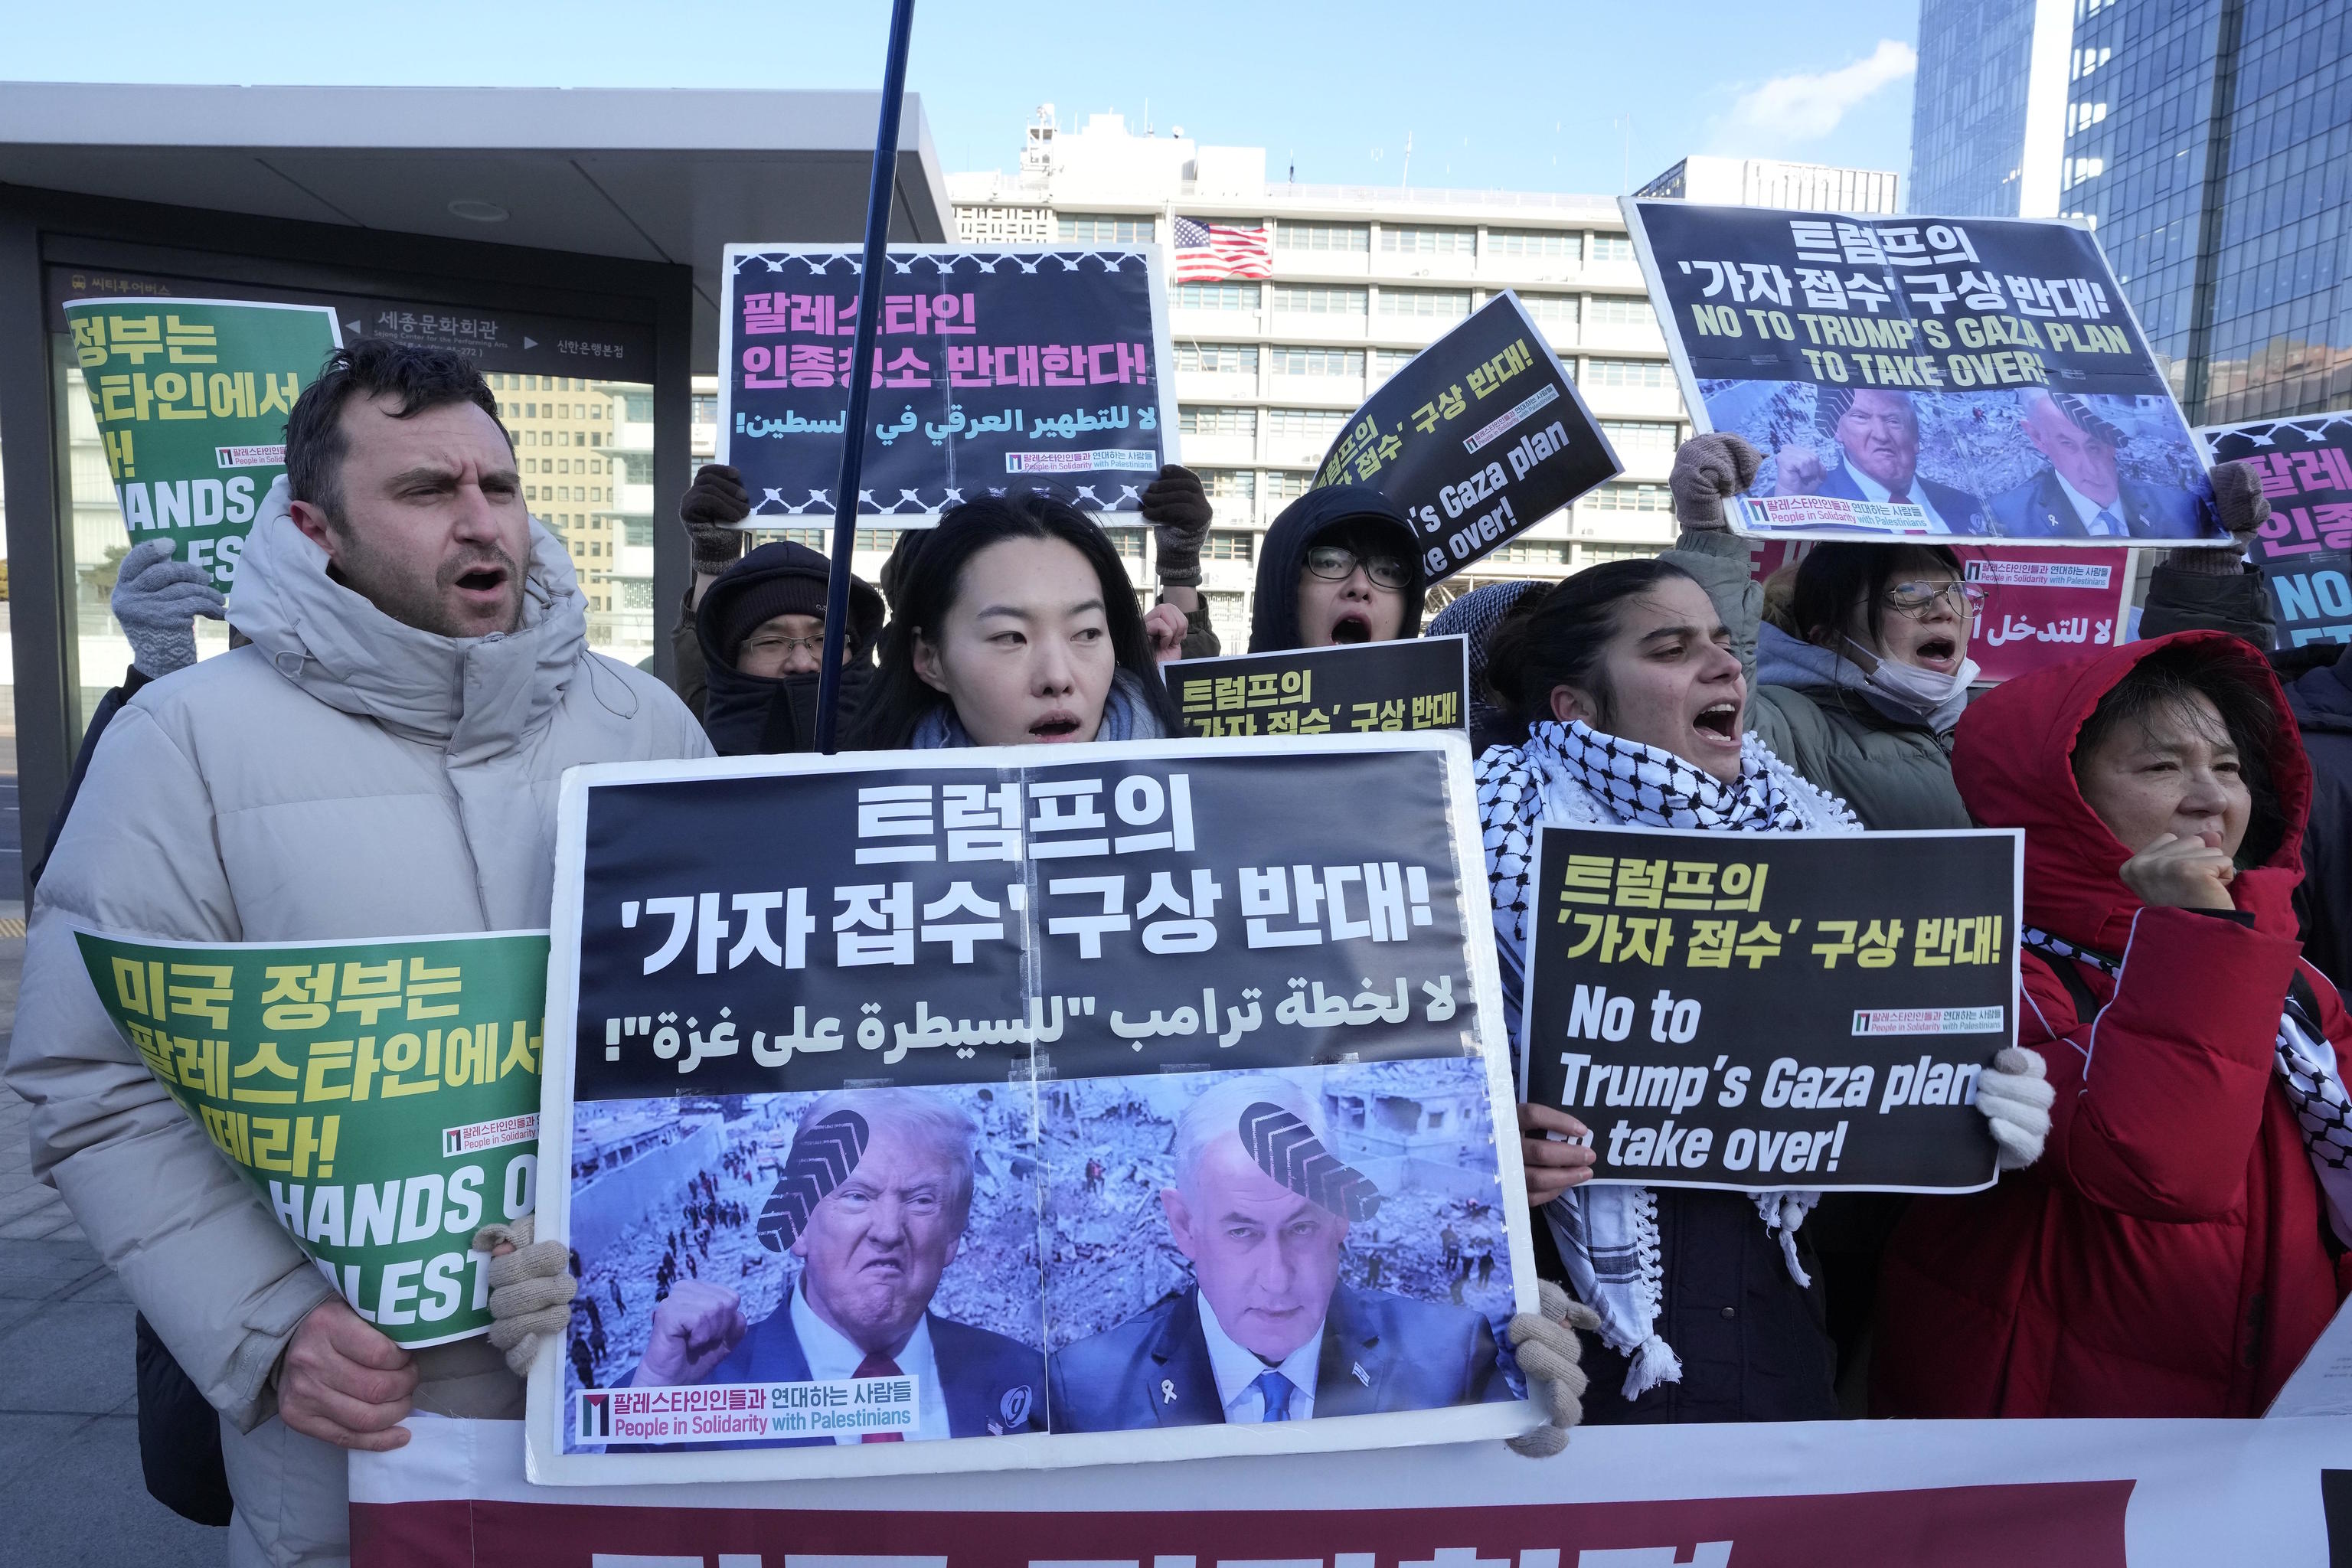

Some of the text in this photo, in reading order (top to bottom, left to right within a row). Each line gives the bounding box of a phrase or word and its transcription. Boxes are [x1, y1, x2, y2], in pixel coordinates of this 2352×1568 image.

[1789, 220, 1980, 266] 트럼프의
[92, 278, 171, 296] 씨티투어버스
[1678, 261, 2110, 318] '가자 접수' 구상 반대!
[70, 315, 217, 368] 정부는
[378, 312, 498, 340] 세종문화회관
[454, 338, 492, 348] Performing
[1690, 304, 2132, 354] NO TO TRUMP'S GAZA PLAN
[557, 340, 623, 358] 신한은행본점
[947, 342, 1146, 387] 반대한다!
[1801, 348, 2050, 387] TO TAKE OVER!
[1411, 384, 1466, 434] 구상
[1466, 338, 1534, 400] 반대!
[1515, 397, 1537, 414] 연대하는
[1537, 386, 1553, 400] 사람들
[876, 404, 917, 446] في
[925, 404, 1023, 446] العرقي
[1029, 405, 1130, 439] للتطهير
[1137, 407, 1157, 430] لا
[1478, 433, 1494, 446] People
[1498, 417, 1520, 433] Solidarity
[1519, 410, 1529, 419] with
[1528, 393, 1557, 413] Palestinians
[1024, 453, 1090, 462] 팔레스타인인들과
[1128, 452, 1152, 460] 사람들
[1024, 463, 1048, 472] People
[1059, 462, 1092, 470] Solidarity
[1439, 421, 1570, 518] Gaza plan
[1449, 496, 1517, 559] over!
[1766, 498, 1922, 517] 팔레스타인인들과 연대하는 사람들
[1771, 511, 1927, 527] People in Solidarity with Palestinians
[1981, 563, 2108, 577] 팔레스타인인들과 연대하는 사람들
[1981, 573, 2004, 582] People
[2005, 573, 2011, 582] in
[2014, 574, 2047, 584] Solidarity
[2066, 577, 2106, 586] Palestinians
[1987, 615, 2089, 646] للتدخل
[2094, 619, 2112, 644] لا
[1182, 669, 1312, 713] 트럼프의
[1351, 698, 1405, 732] 구상
[1413, 691, 1457, 730] 반대!
[855, 773, 1195, 865] 트럼프의
[1560, 854, 1769, 912] 트럼프의
[621, 862, 1432, 975] '가자 접수' 구상 반대!
[1557, 909, 2002, 969] '가자 접수' 구상 반대!
[112, 956, 462, 1031] 미국 정부는
[1275, 976, 1410, 1027] لخطة
[1421, 975, 1457, 1022] لا
[1566, 984, 1702, 1044] No to
[1110, 988, 1262, 1052] ترامب
[1871, 1024, 1896, 1033] People
[1906, 1023, 1940, 1033] Solidarity
[1960, 1021, 2001, 1030] Palestinians
[1872, 1009, 2001, 1021] 팔레스타인인들과 연대하는 사람들
[751, 1006, 844, 1068] على
[1560, 1052, 1982, 1115] Trump's Gaza plan
[199, 1103, 340, 1178] 떼라!
[463, 1116, 534, 1138] 팔레스타인인들과
[464, 1129, 536, 1150] People in Solidarity
[1607, 1120, 1713, 1168] take
[1723, 1120, 1849, 1174] over!
[269, 1165, 484, 1247] HANDS
[614, 1381, 911, 1415] 팔레스타인인들과 연대하는 사람들
[615, 1409, 911, 1439] People in Solidarity with Palestinians
